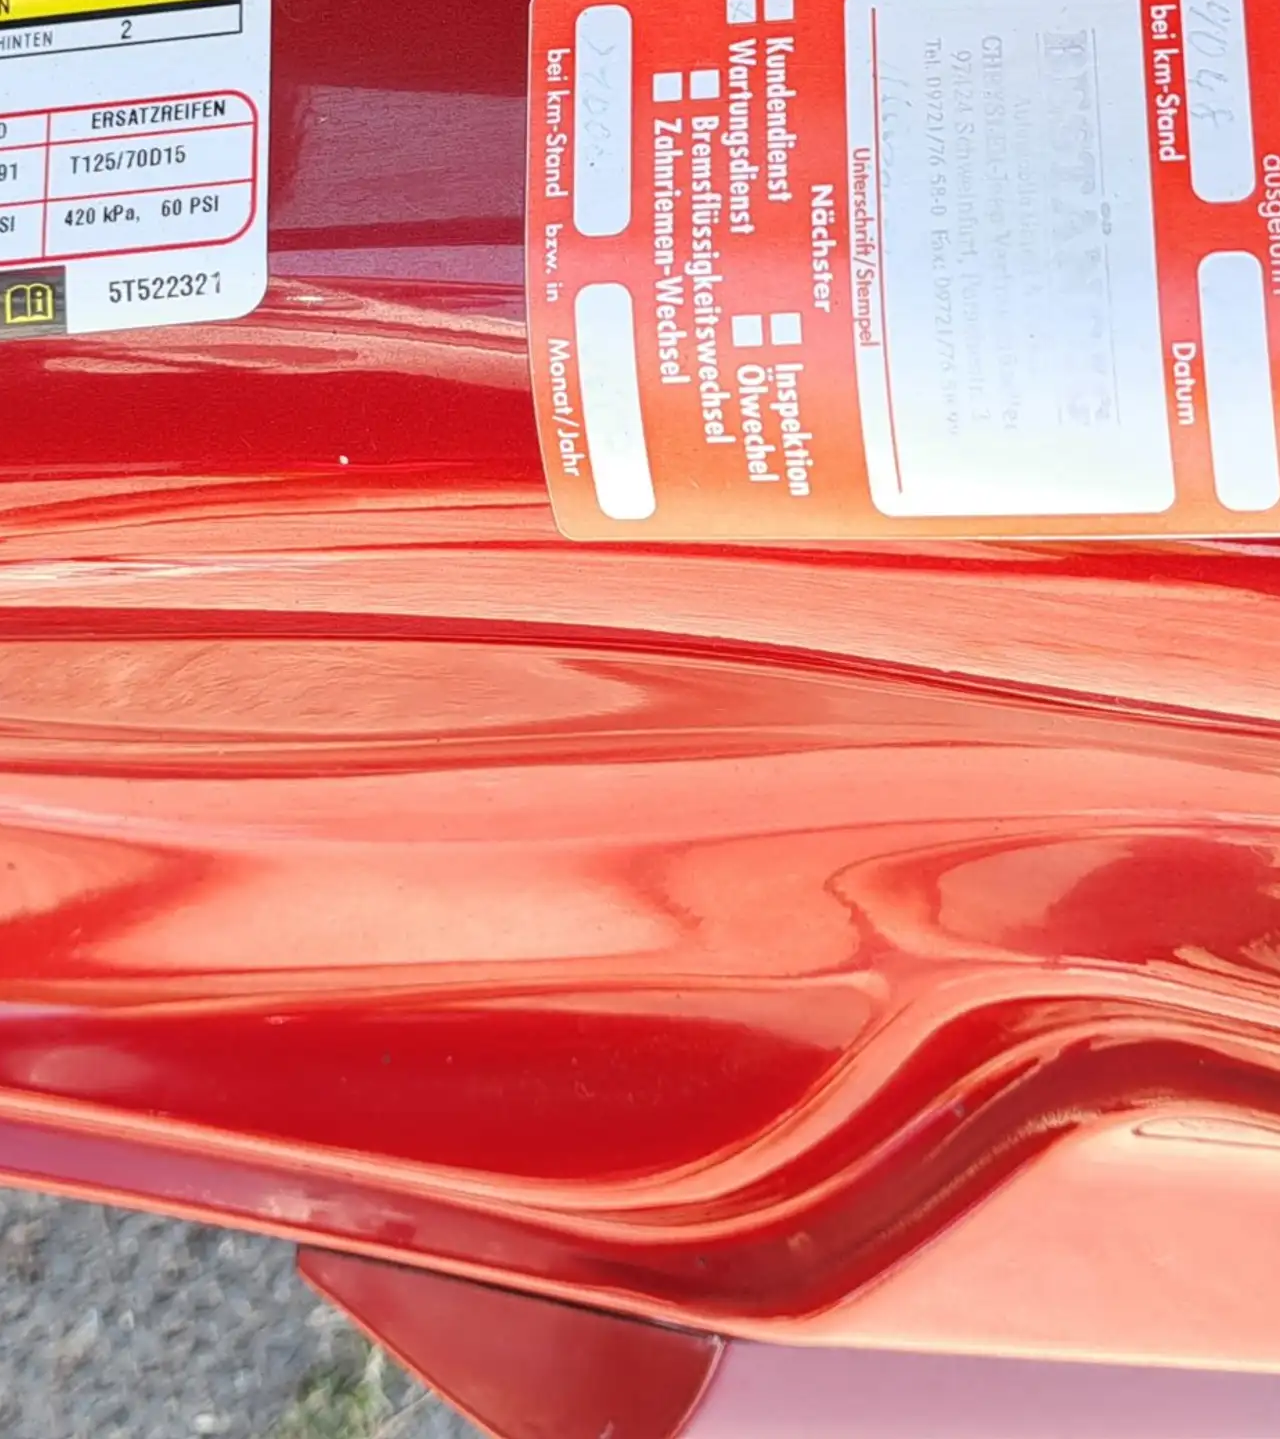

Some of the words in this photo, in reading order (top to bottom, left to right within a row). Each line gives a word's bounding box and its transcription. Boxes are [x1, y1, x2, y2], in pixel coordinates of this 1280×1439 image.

[120, 19, 133, 40] 2
[547, 47, 571, 89] bei
[922, 37, 943, 69] Tel.
[1149, 3, 1177, 49] bei
[91, 100, 226, 130] ERSATZREIFEN
[544, 91, 570, 200] km-Stand
[721, 36, 758, 236] Wartungsdienst
[764, 36, 794, 203] Kundendienst
[923, 75, 947, 167] 09721/76
[1151, 51, 1187, 163] km-Stand
[70, 145, 187, 175] T125/70D15
[64, 207, 96, 227] 420
[103, 203, 141, 225] kPa,
[161, 198, 182, 218] 60
[189, 195, 220, 215] PSI
[544, 222, 564, 275] bzw.
[652, 117, 692, 387] Zahnriemen-Wechsel
[809, 183, 833, 313] Nächster
[852, 146, 883, 349] Unterschrift/Stempel
[545, 280, 564, 303] in
[686, 114, 737, 446] Bremsflüssigkeitswechsel
[547, 337, 580, 478] Monat/Jahr
[735, 362, 780, 483] Ölwechel
[770, 362, 813, 498] Inspektion
[1172, 341, 1196, 426] Datum
